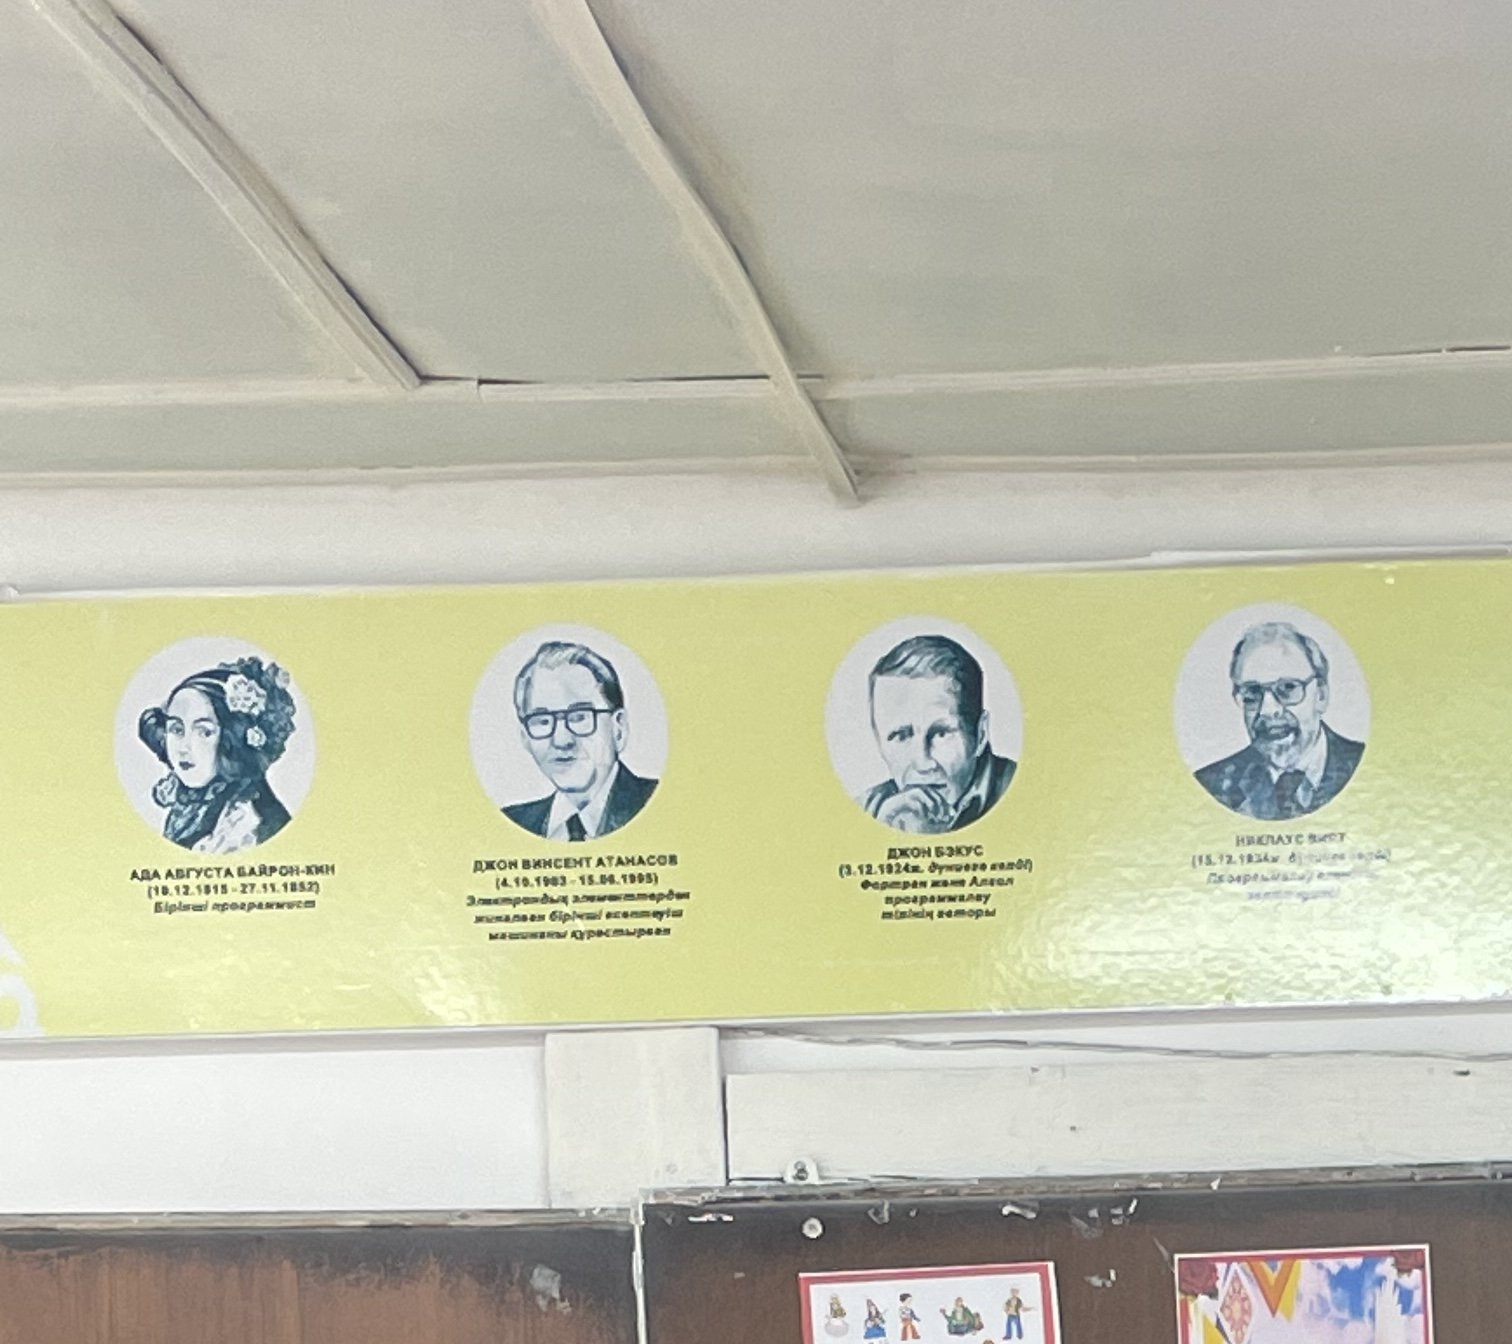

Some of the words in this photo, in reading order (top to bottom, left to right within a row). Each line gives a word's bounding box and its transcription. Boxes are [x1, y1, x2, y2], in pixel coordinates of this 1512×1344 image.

[887, 846, 932, 860] ДЖОН
[935, 844, 984, 859] БЭКУС
[473, 859, 518, 873] ДЖОН
[522, 856, 593, 870] ВИНСЕНТ
[596, 854, 678, 868] АТАНАСОВ
[130, 868, 160, 882] АДА
[165, 866, 234, 880] АВГУСТА
[861, 879, 927, 891] Фортран
